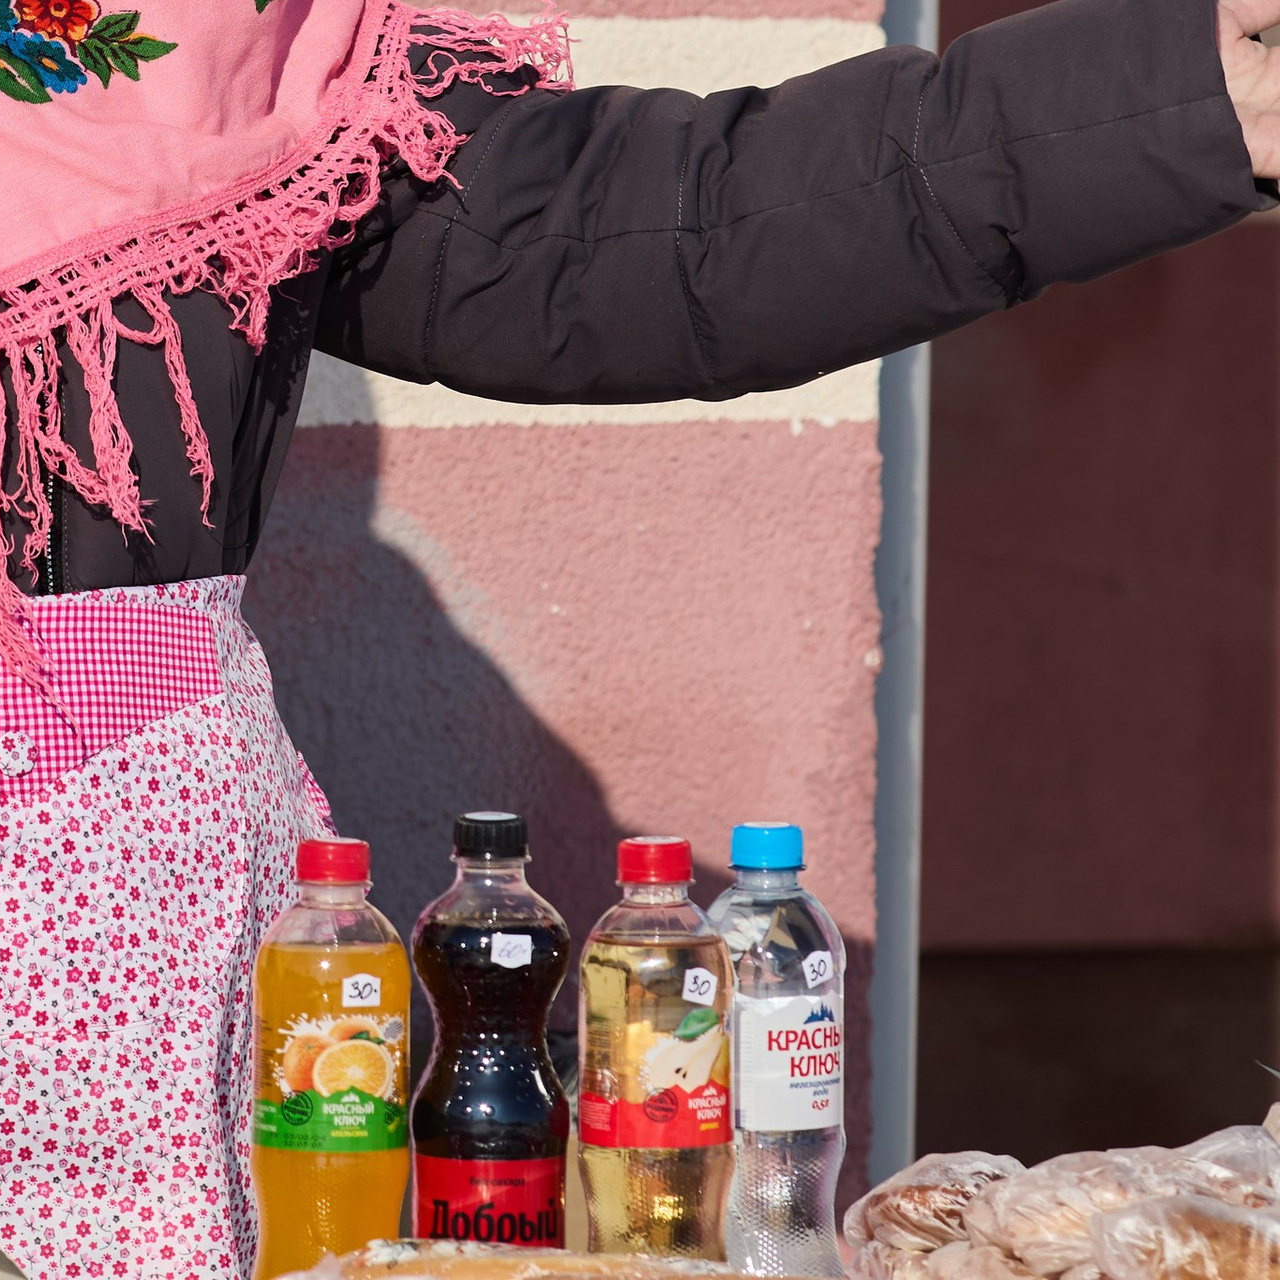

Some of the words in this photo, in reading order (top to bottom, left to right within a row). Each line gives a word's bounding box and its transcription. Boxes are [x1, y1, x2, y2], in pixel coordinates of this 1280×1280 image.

[810, 959, 827, 982] 30
[322, 1102, 375, 1115] КРАСНЫЙ
[688, 1094, 727, 1110] КРАСНЫЙ
[333, 1115, 367, 1127] КЛЮЧ
[696, 1108, 722, 1121] КЛЮЧ
